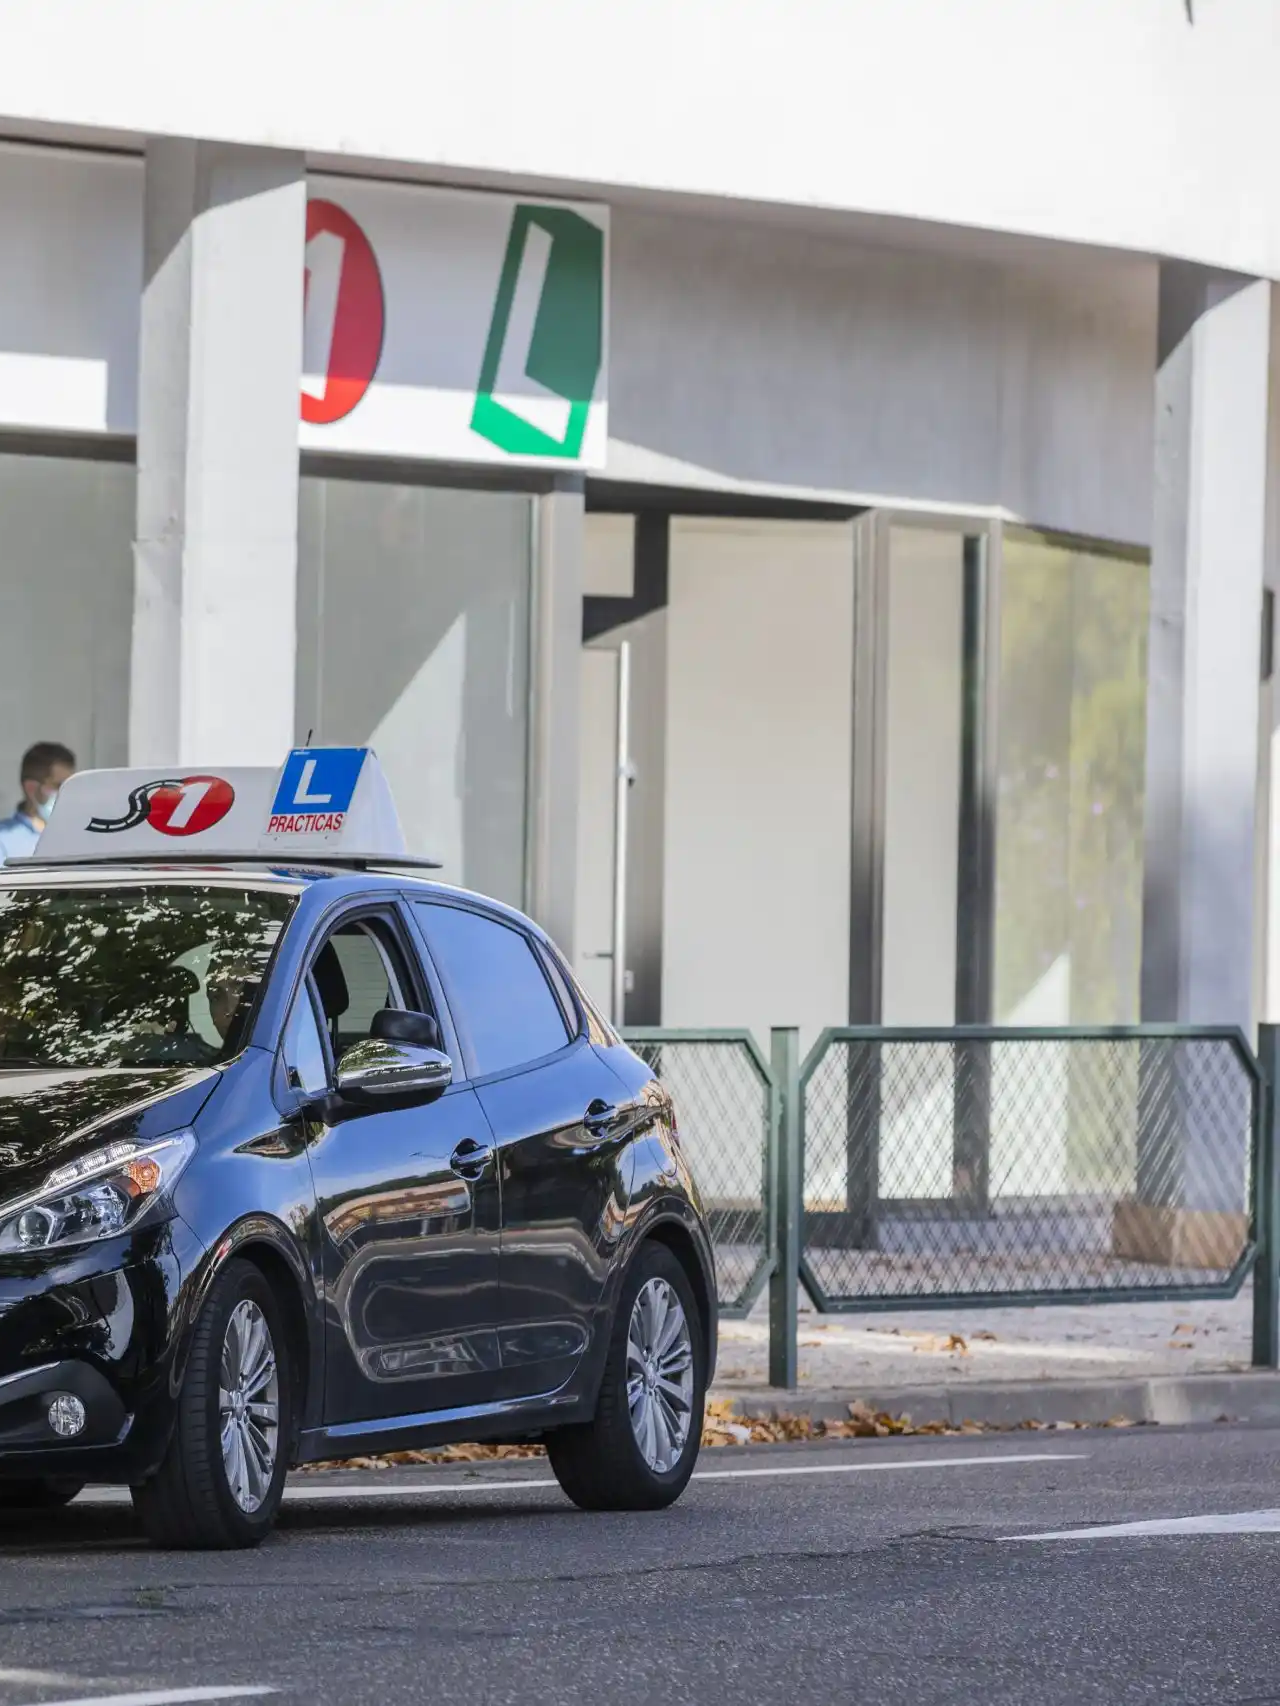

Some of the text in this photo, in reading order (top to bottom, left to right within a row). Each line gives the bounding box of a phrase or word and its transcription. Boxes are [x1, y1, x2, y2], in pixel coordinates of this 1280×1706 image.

[490, 221, 572, 444] L
[293, 760, 332, 804] L
[267, 813, 344, 833] PRACTICAS
